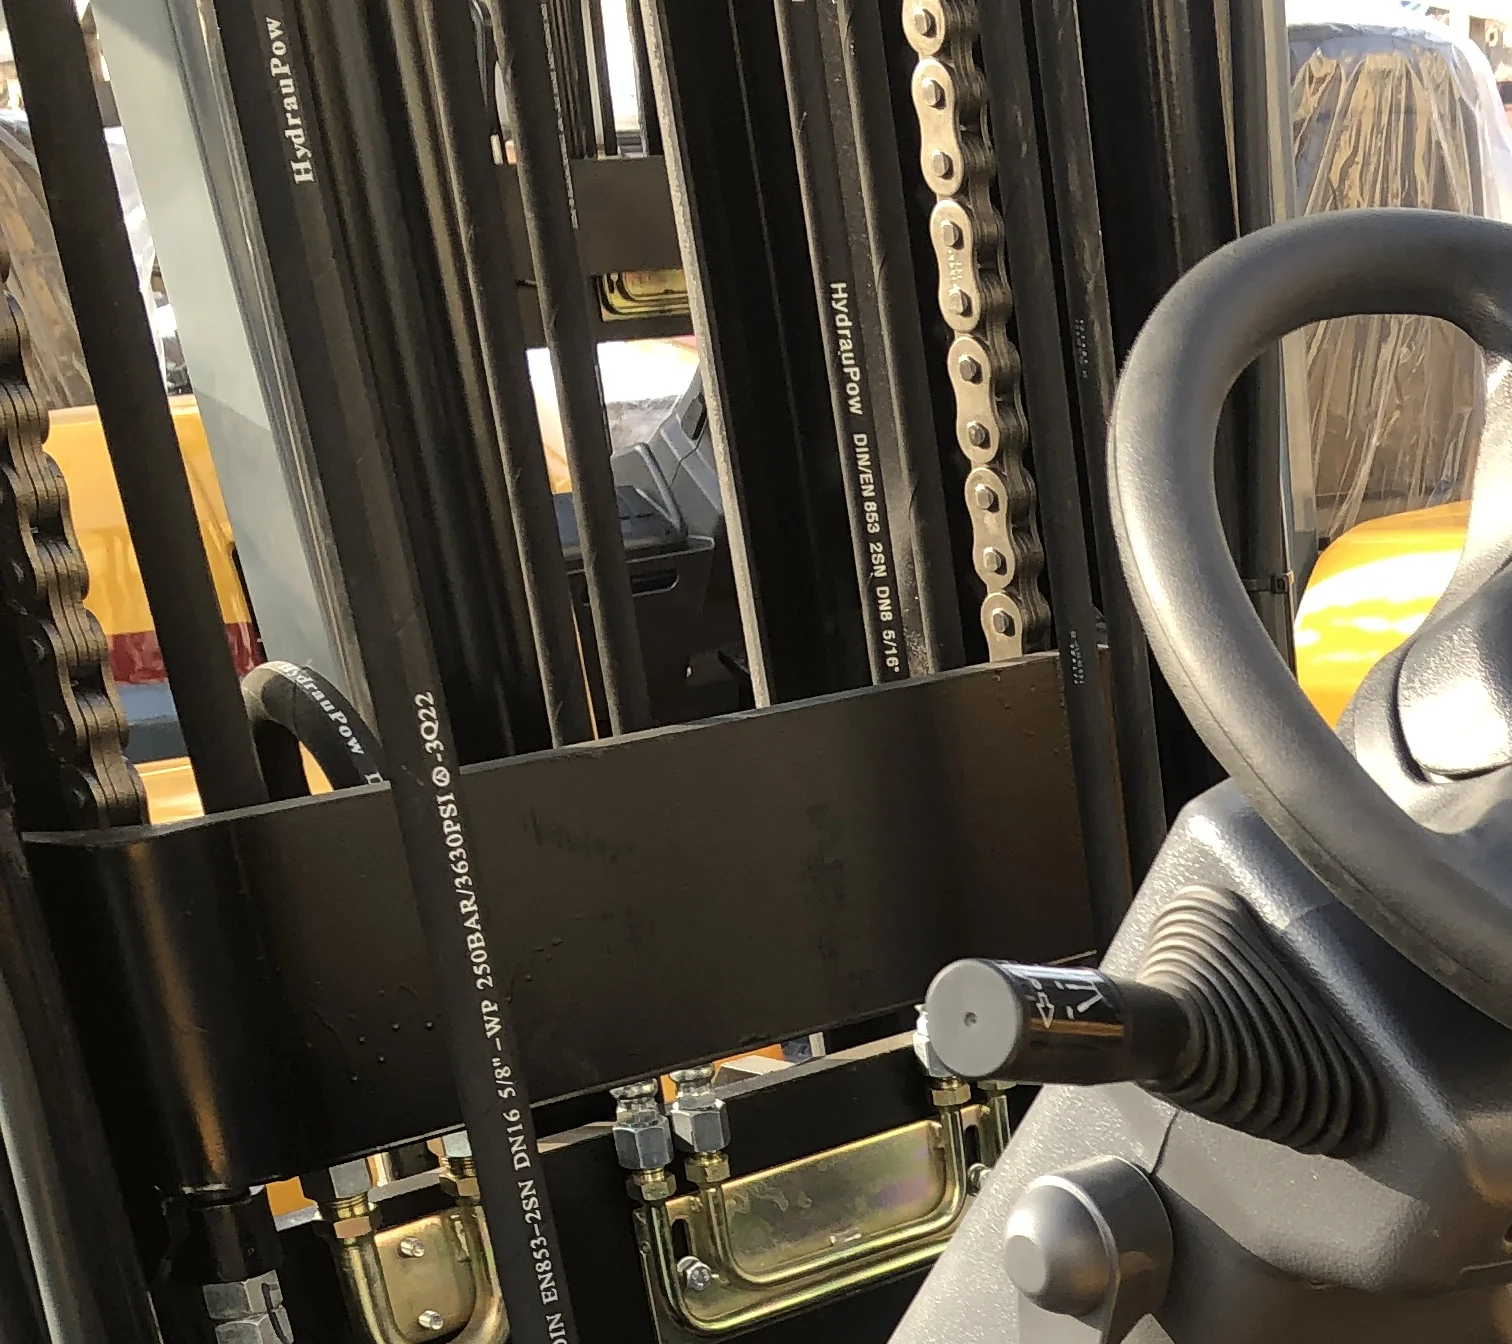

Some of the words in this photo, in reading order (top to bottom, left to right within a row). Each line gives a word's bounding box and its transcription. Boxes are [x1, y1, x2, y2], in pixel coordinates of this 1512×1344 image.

[265, 16, 316, 185] HydrauPow
[830, 282, 863, 415] HydrauPow
[852, 432, 876, 495] DIN/EN
[864, 500, 880, 534] 853
[869, 541, 887, 577] 2SN
[875, 585, 893, 622] DN8
[276, 662, 365, 756] HydrauPow
[436, 792, 494, 990] 250BAR/3630PSI
[503, 1108, 531, 1171] DN16
[517, 1178, 559, 1305] EN853-2SN
